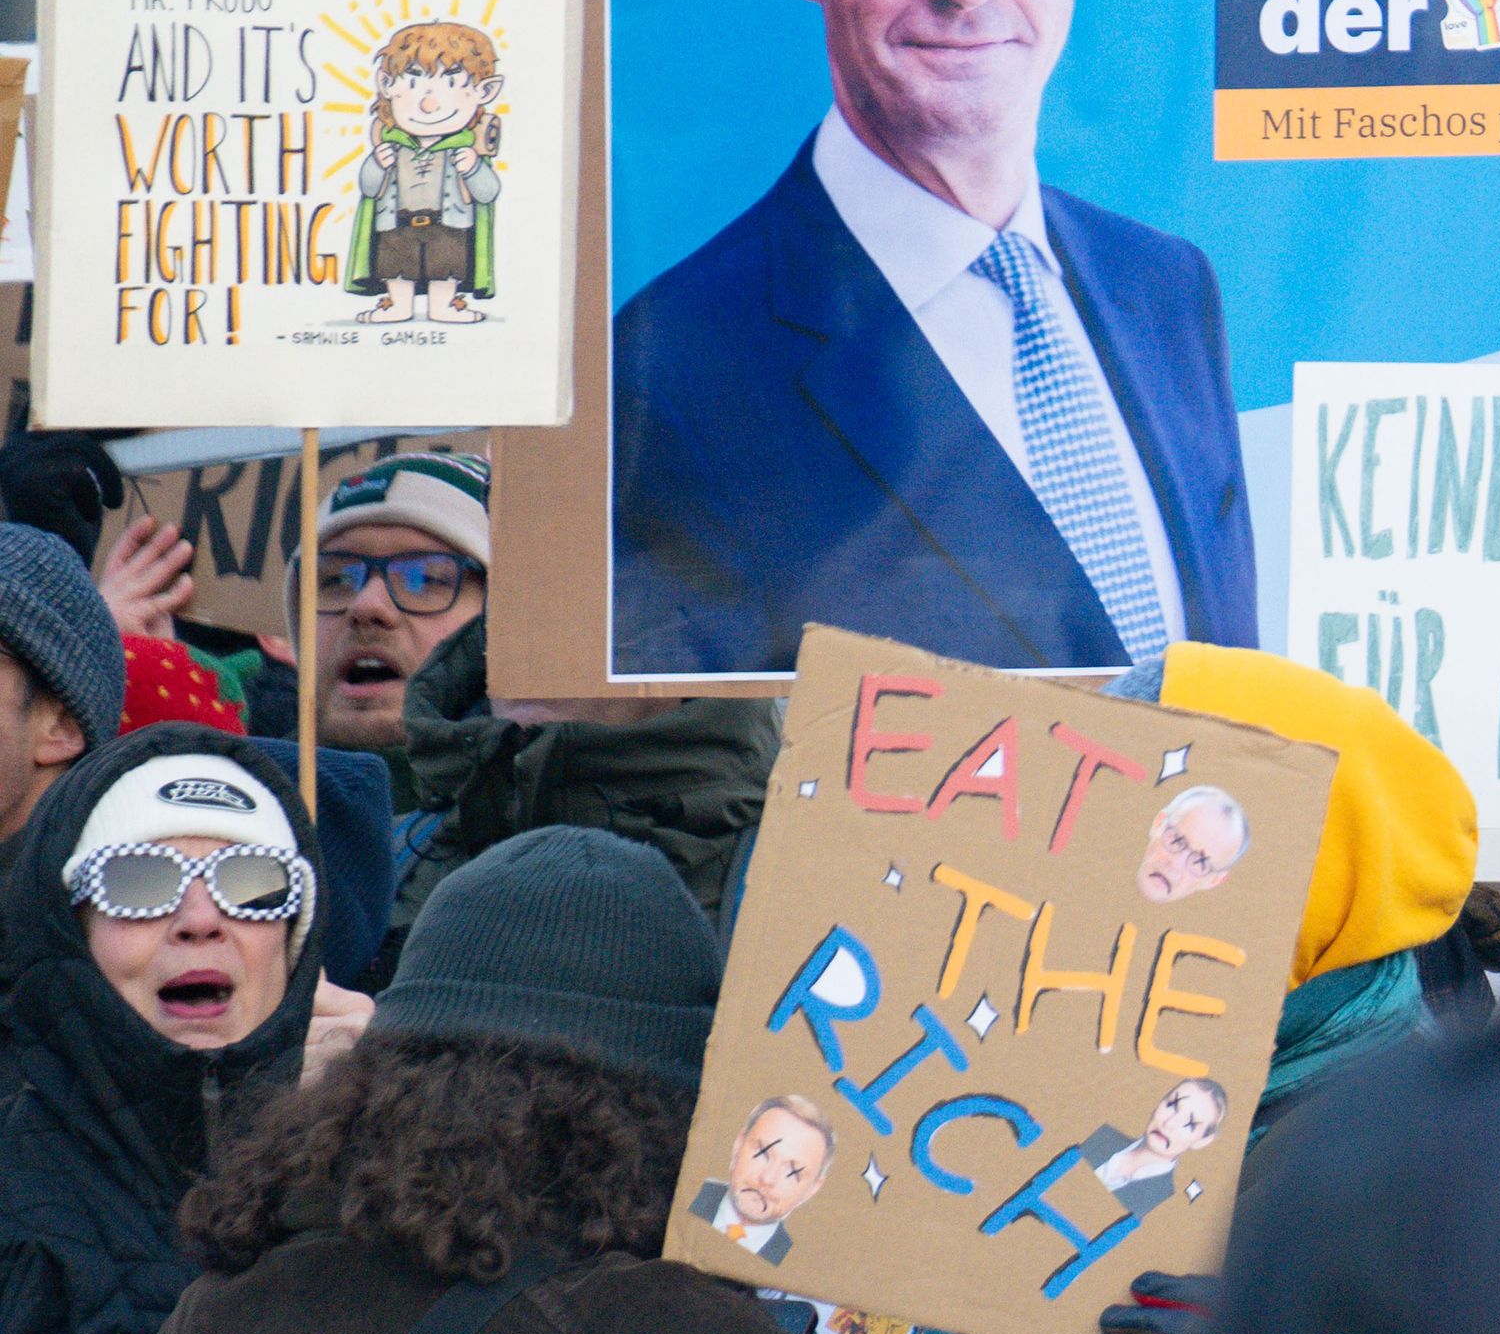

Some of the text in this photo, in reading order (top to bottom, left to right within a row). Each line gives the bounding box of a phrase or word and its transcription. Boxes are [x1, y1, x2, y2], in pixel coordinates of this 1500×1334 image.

[117, 24, 318, 104] AND IT'S
[115, 111, 313, 196] WORTH
[1261, 106, 1324, 145] Mit
[1334, 102, 1487, 141] Faschos
[115, 199, 339, 287] FIGHTING
[115, 287, 241, 346] FOR!
[381, 331, 448, 347] GAMGEE
[846, 673, 1146, 856] EAT
[930, 862, 1247, 1078] THE
[766, 924, 1142, 1300] RICH
